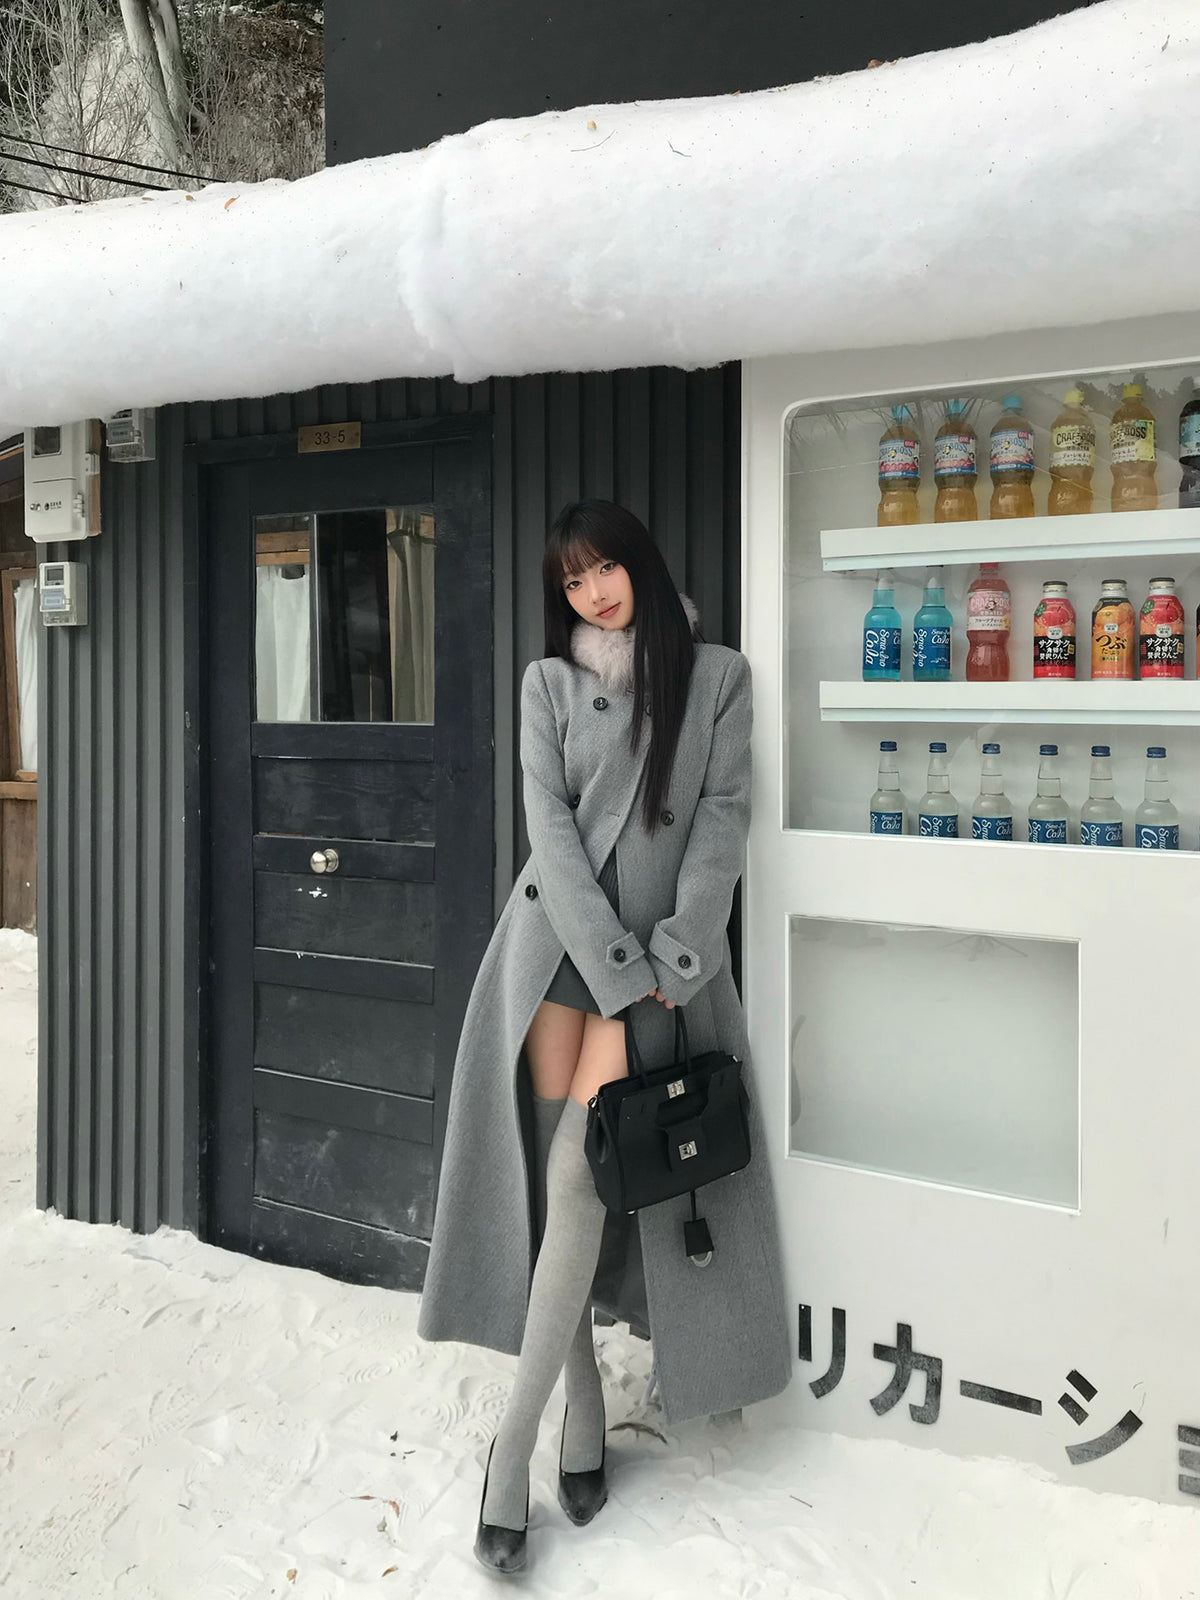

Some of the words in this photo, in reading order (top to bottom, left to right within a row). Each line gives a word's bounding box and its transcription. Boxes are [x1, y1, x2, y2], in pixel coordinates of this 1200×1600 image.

[314, 430, 346, 446] 33-5
[931, 634, 949, 644] Cola
[1038, 639, 1071, 648] サクサク
[1095, 634, 1127, 650] つぶ
[1146, 637, 1180, 647] サクサク
[865, 630, 879, 665] Cola
[882, 820, 900, 830] Cola
[920, 816, 932, 835] Co
[1141, 828, 1158, 849] Co
